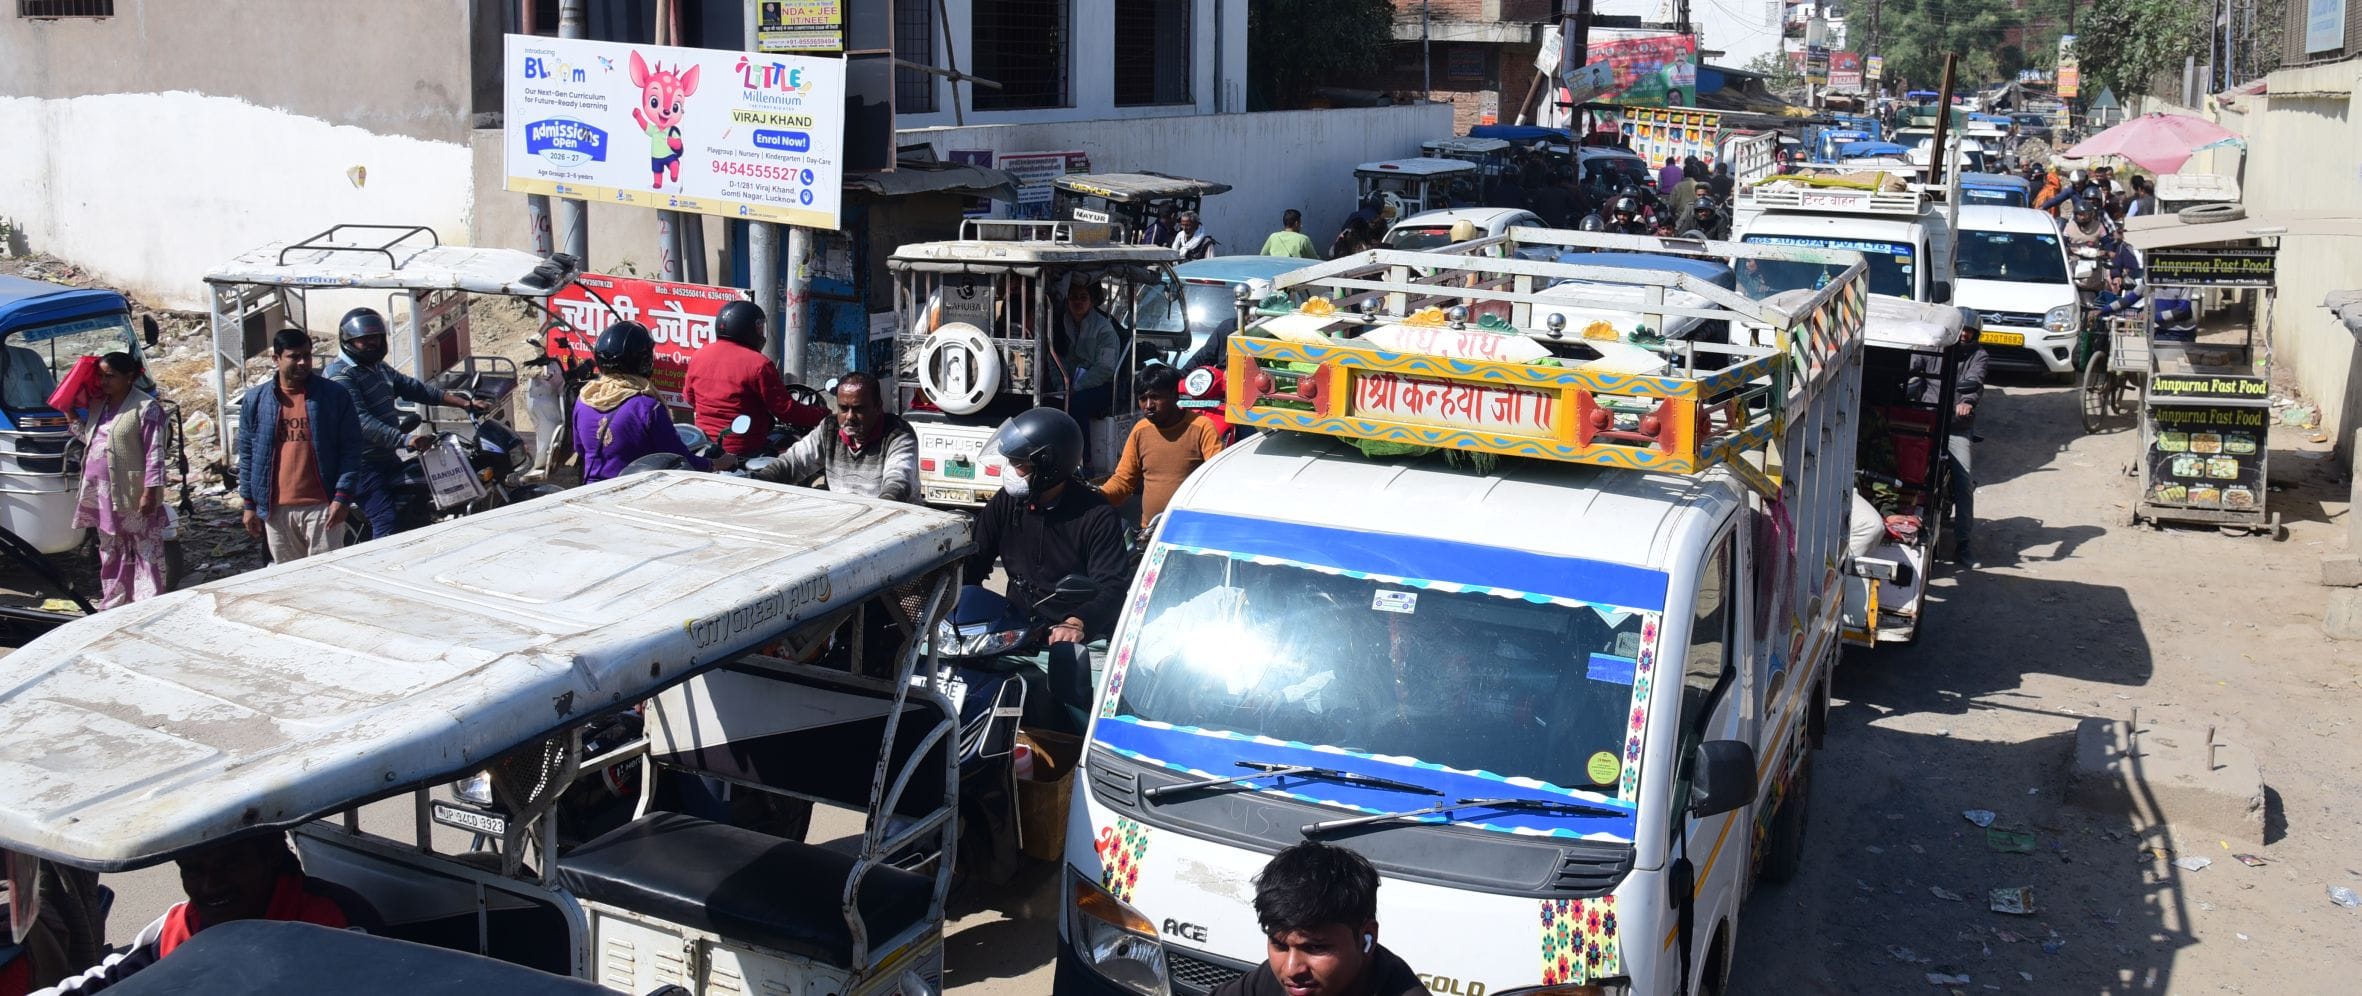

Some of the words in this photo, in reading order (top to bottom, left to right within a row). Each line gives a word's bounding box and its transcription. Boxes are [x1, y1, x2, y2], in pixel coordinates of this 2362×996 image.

[782, 7, 805, 16] NDA
[818, 7, 838, 15] JEE
[790, 16, 829, 24] IIT/NEET
[525, 48, 556, 57] Introducing
[525, 87, 536, 95] Our
[537, 89, 568, 98] Next-Gen
[569, 92, 606, 101] Curriculum
[743, 90, 802, 106] Millennium
[534, 97, 578, 109] Future-Ready
[579, 101, 608, 112] Learning
[733, 112, 767, 124] VIRAJ
[770, 114, 812, 127] KHAND
[756, 134, 780, 144] Enrol
[782, 136, 806, 147] Now!
[550, 152, 565, 161] 2026
[571, 154, 580, 162] 27
[707, 146, 734, 156] Playgroup
[738, 150, 760, 159] Nursery
[765, 152, 801, 163] Kindergarten
[806, 156, 832, 166] Day-Care
[712, 160, 798, 181] 9454555527
[755, 182, 771, 193] Viraj
[721, 189, 741, 198] Gomti
[765, 194, 796, 204] Lucknow
[1829, 196, 1856, 207] वाहन
[1075, 210, 1107, 222] MAYUR
[2152, 257, 2210, 276] Annpurna
[2212, 258, 2240, 274] Fast
[2241, 258, 2271, 274] Food
[648, 300, 718, 350] ज्वैल
[2152, 377, 2209, 394] Annpurna
[2211, 378, 2237, 394] Fast
[2238, 379, 2267, 395] Food
[2154, 408, 2207, 427] Annpurna
[2208, 409, 2233, 425] Fast
[2235, 410, 2263, 426] Food
[789, 573, 832, 614] AUTO
[443, 809, 454, 820] UP
[1162, 917, 1208, 944] ACE
